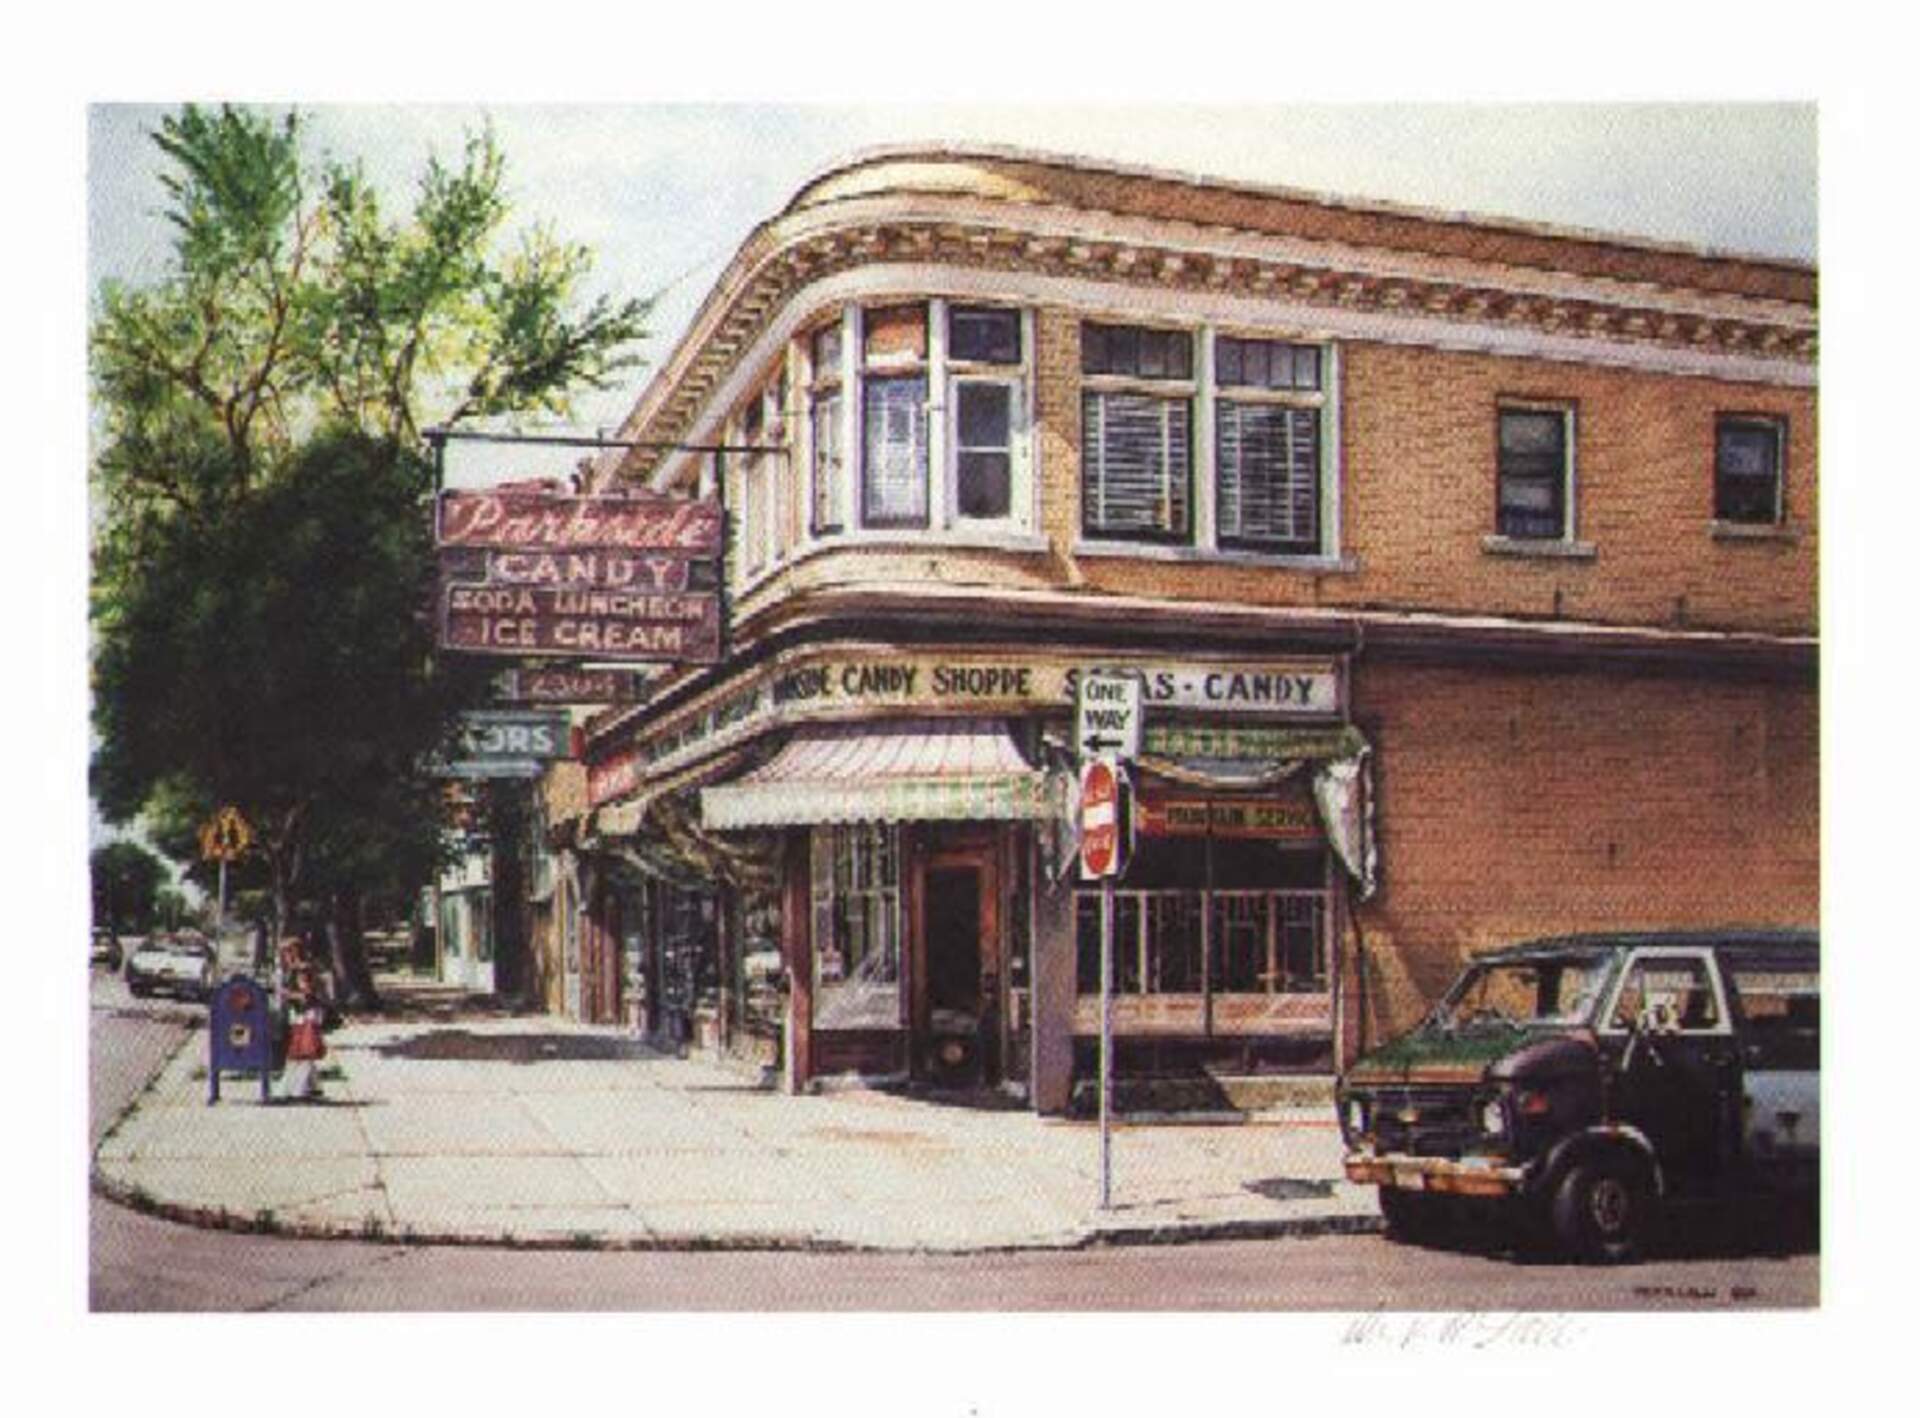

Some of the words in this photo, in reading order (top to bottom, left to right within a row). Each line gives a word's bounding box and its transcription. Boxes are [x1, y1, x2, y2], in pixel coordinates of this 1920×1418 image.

[496, 553, 672, 589] CANDY
[452, 591, 536, 612] SODA
[554, 592, 704, 618] LUNCHEON
[481, 618, 537, 645] ICE
[554, 620, 682, 650] CREAM
[841, 666, 917, 696] CANDY
[931, 667, 1031, 696] SHOPPE
[1203, 673, 1314, 705] CANDY
[1086, 680, 1127, 702] ONE
[1085, 709, 1130, 730] WAY
